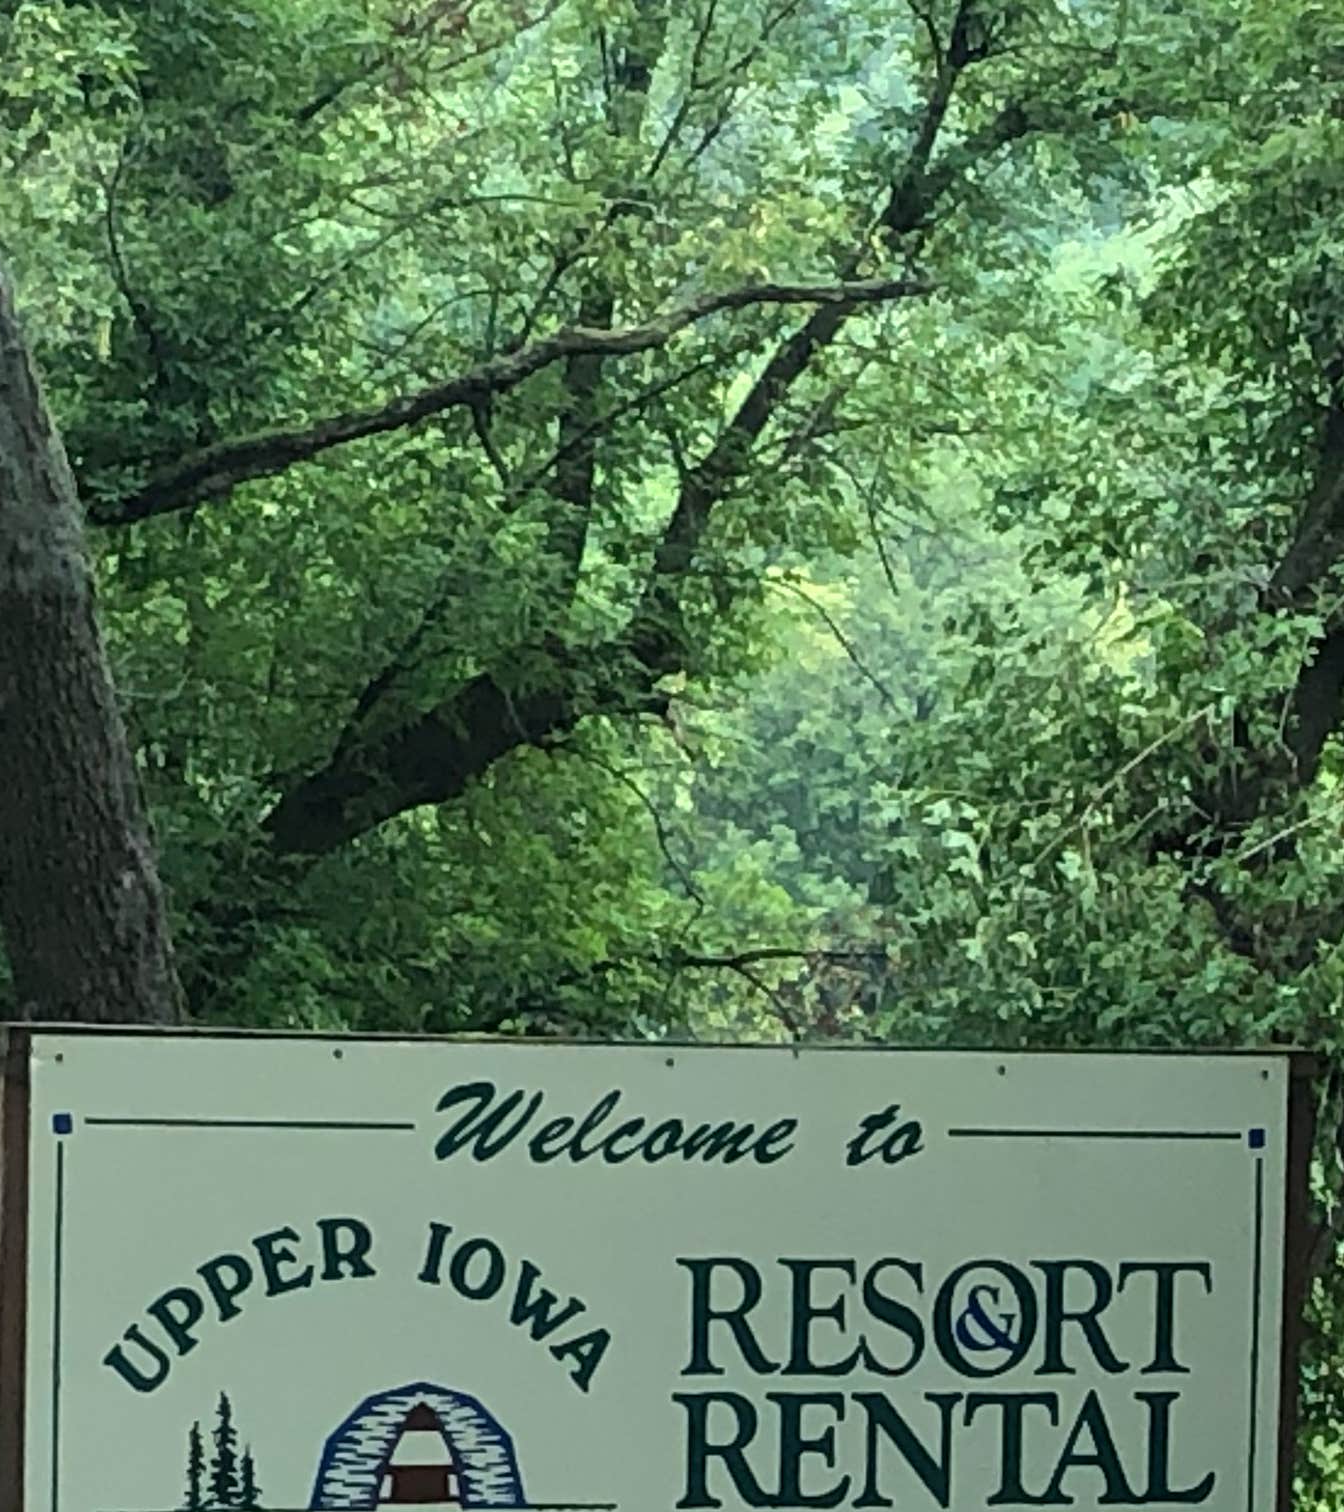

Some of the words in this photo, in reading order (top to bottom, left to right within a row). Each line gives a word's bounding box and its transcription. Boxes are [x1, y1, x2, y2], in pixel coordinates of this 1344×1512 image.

[435, 1082, 797, 1164] Welcome
[847, 1104, 925, 1166] to
[103, 1219, 376, 1392] UPPER
[418, 1222, 612, 1391] IOWA
[676, 1257, 1213, 1378] RESORT
[955, 1284, 1020, 1352] &
[672, 1390, 1216, 1509] RENTAL
